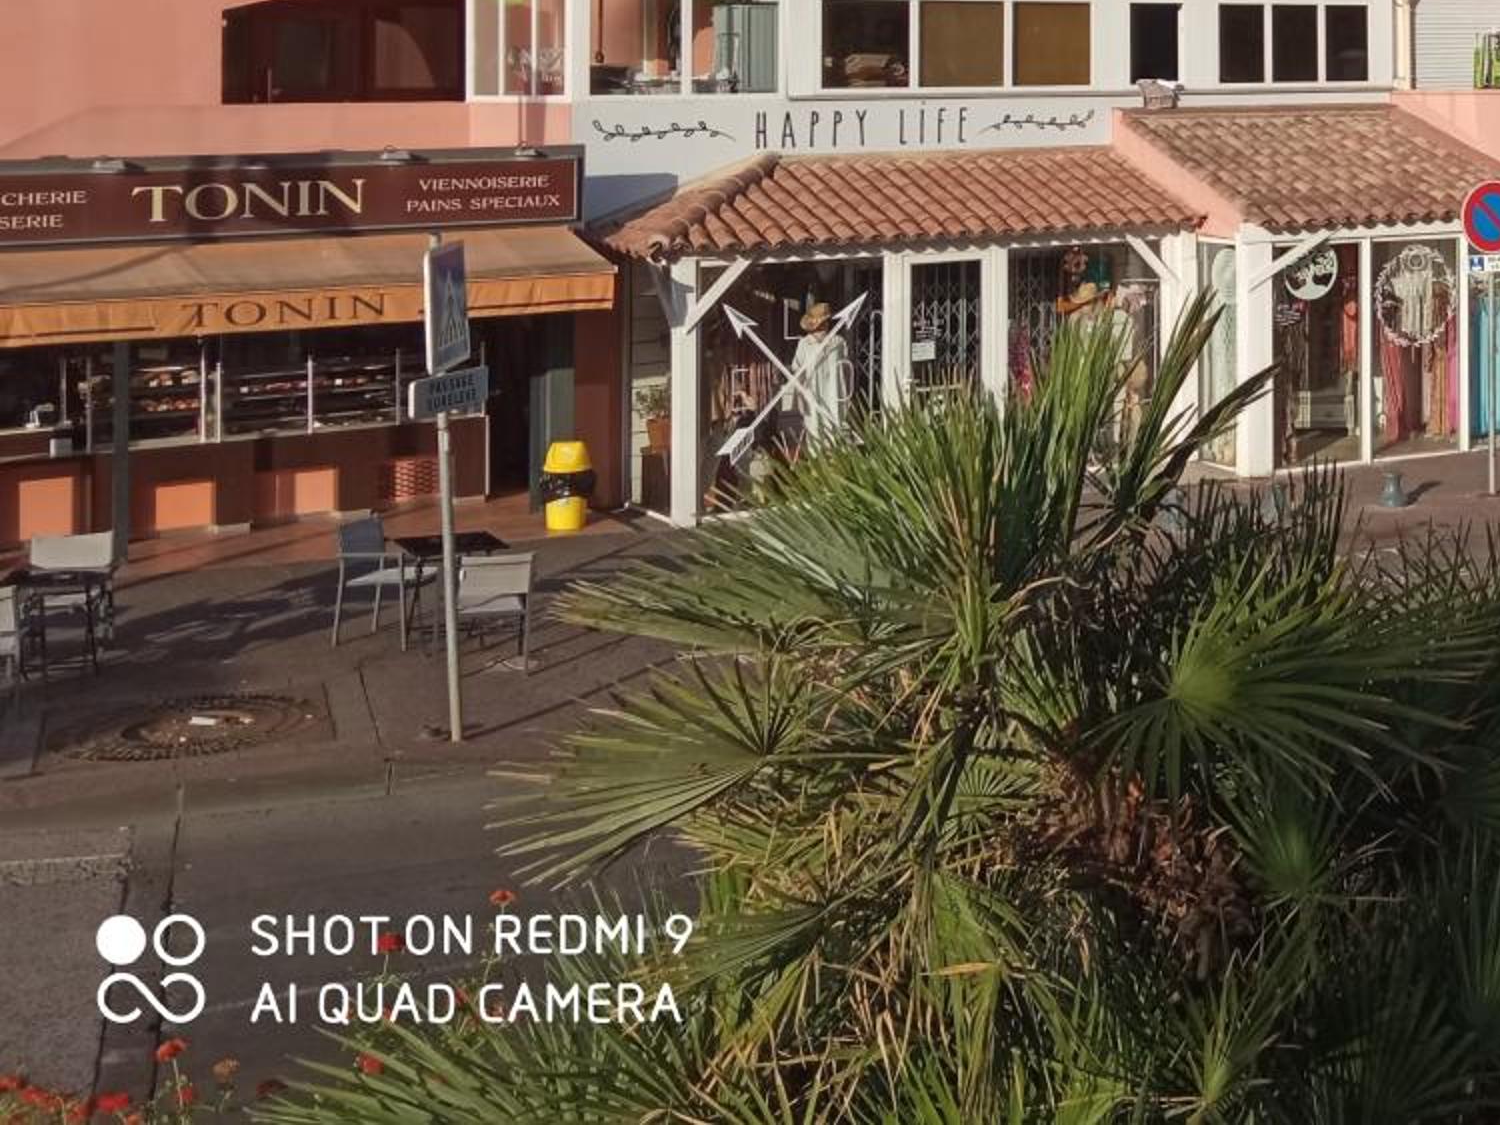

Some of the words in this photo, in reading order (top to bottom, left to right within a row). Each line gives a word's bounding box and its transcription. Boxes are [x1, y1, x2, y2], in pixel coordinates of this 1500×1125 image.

[755, 109, 867, 149] HAPPY
[419, 175, 551, 191] VIENNOISERIE
[1, 190, 88, 206] CHERIE
[131, 178, 366, 223] TONIN
[406, 197, 463, 213] PAINS
[469, 194, 561, 211] SPECIAUX
[181, 293, 386, 328] TONIN
